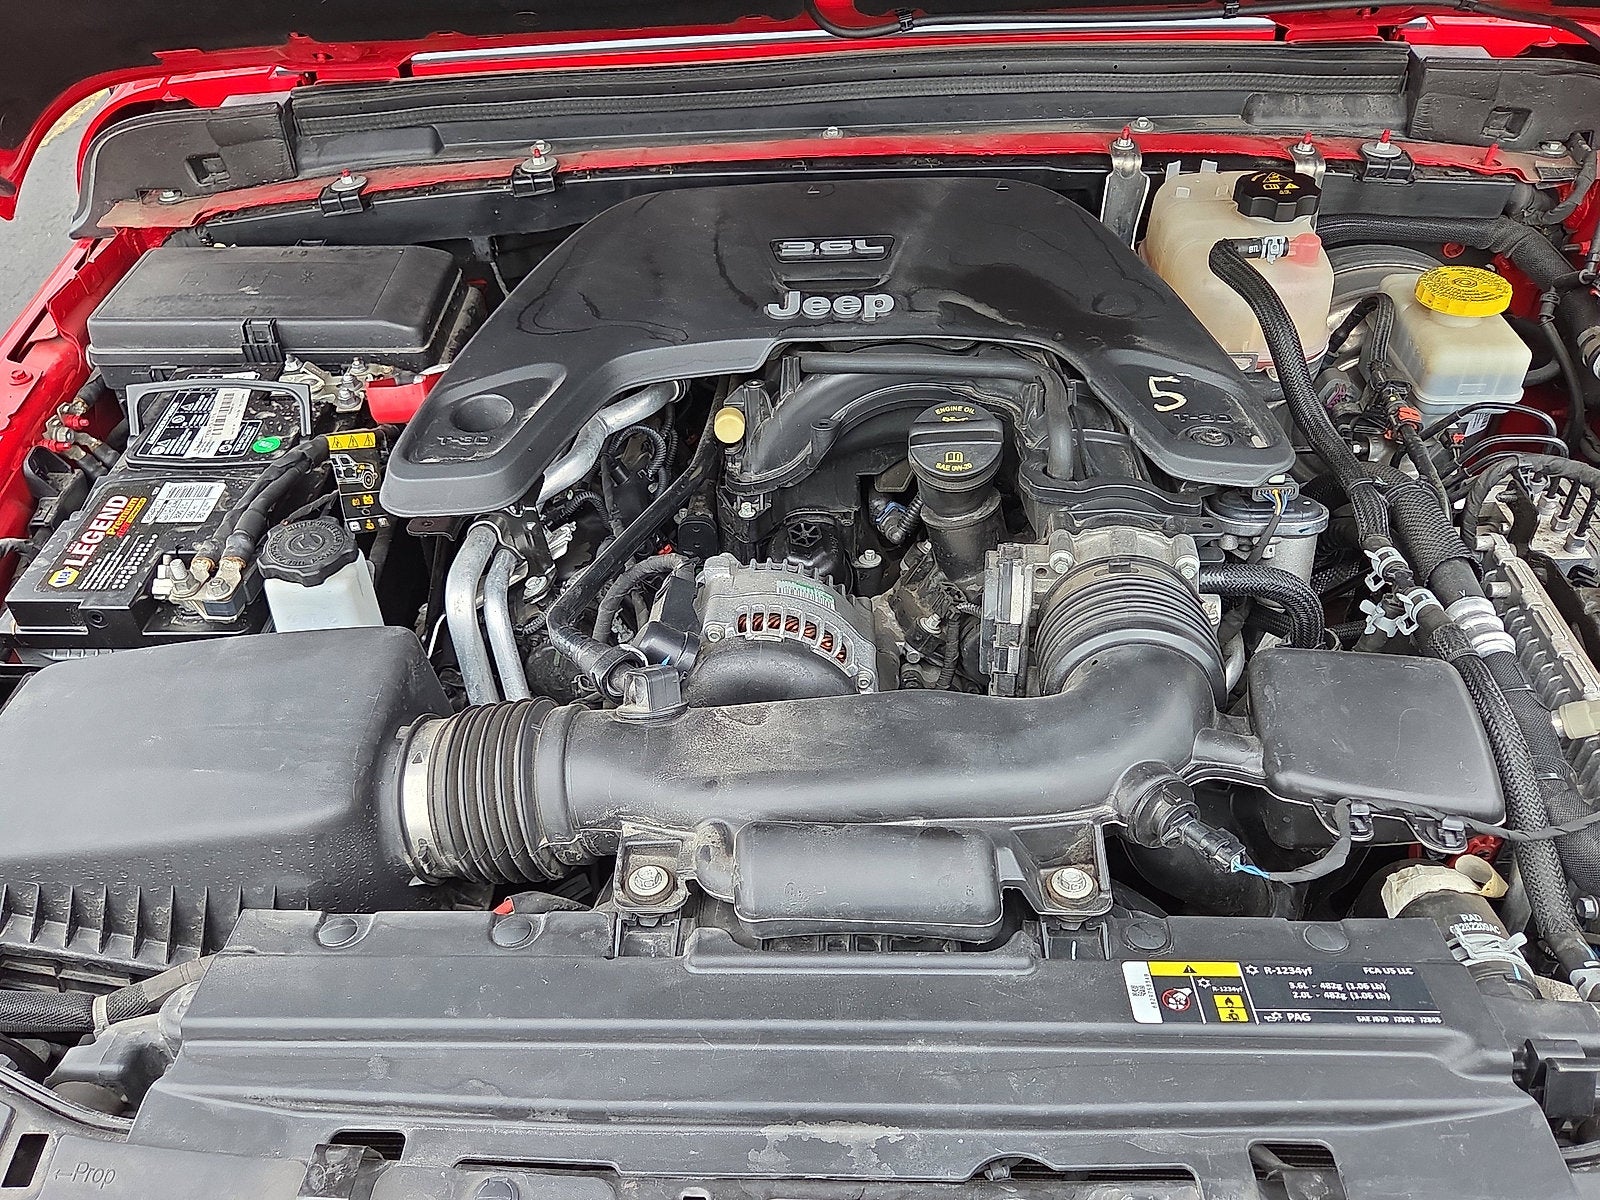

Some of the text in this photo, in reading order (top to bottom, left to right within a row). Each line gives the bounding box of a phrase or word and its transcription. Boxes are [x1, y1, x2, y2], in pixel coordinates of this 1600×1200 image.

[763, 290, 895, 322] Jeep
[1148, 375, 1188, 412] 5
[935, 406, 976, 415] ENGINE OIL
[936, 463, 950, 471] SAE
[105, 496, 141, 537] Premium
[63, 495, 130, 568] LEGEND
[1459, 913, 1483, 922] RAD
[1263, 966, 1314, 977] R-1234yf
[1362, 966, 1415, 975] FCA US LLC
[1286, 1012, 1312, 1022] PAG
[72, 1161, 117, 1190] Prop
